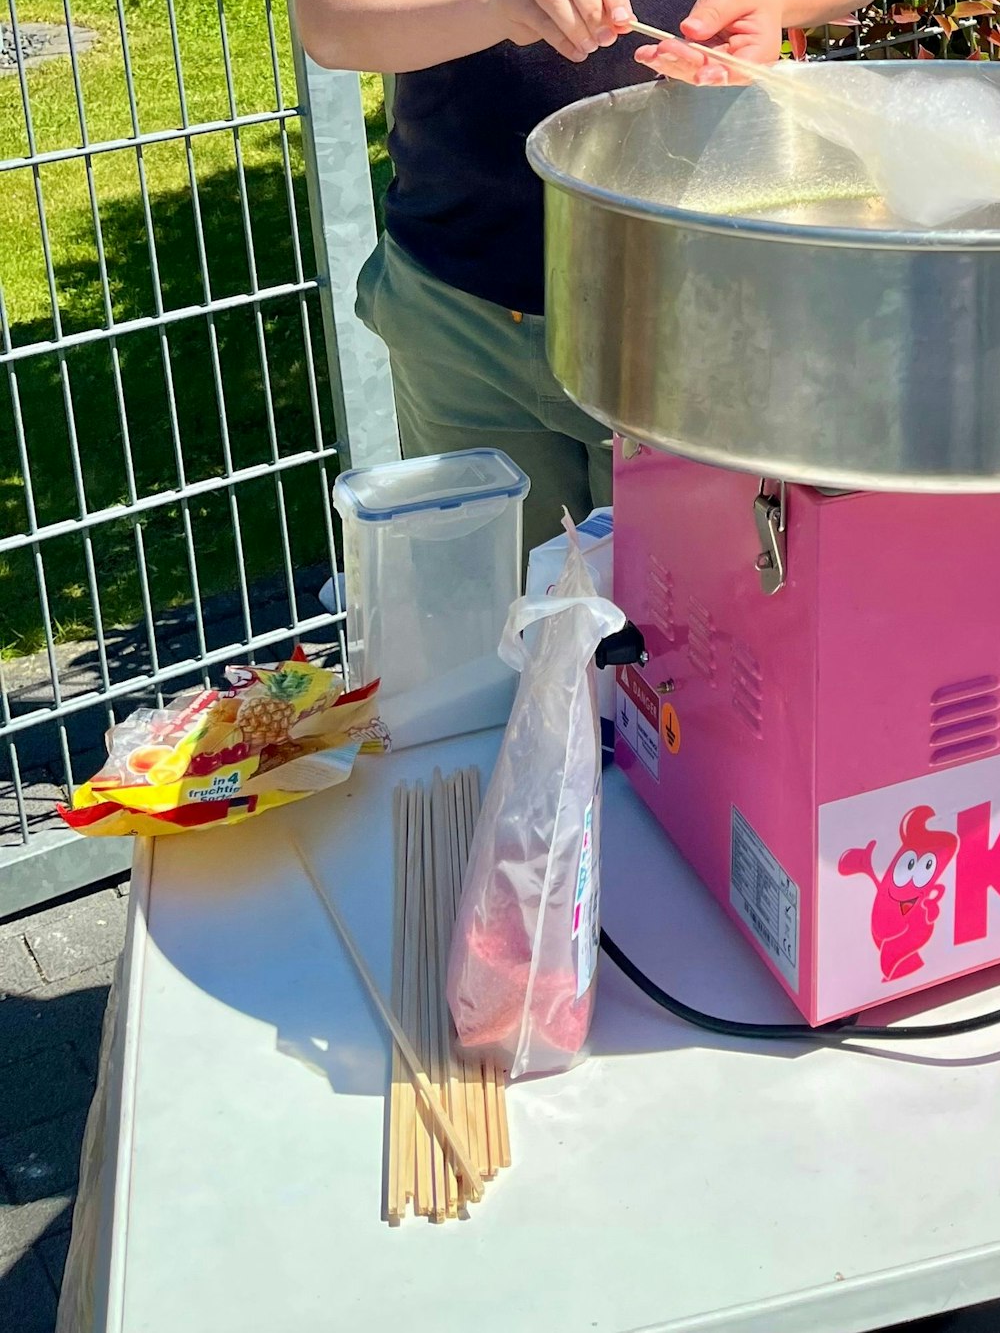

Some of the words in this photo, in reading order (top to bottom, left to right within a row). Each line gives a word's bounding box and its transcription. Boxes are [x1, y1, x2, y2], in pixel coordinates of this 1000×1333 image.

[632, 680, 658, 719] DANGER
[213, 777, 225, 786] in
[227, 772, 239, 784] 4
